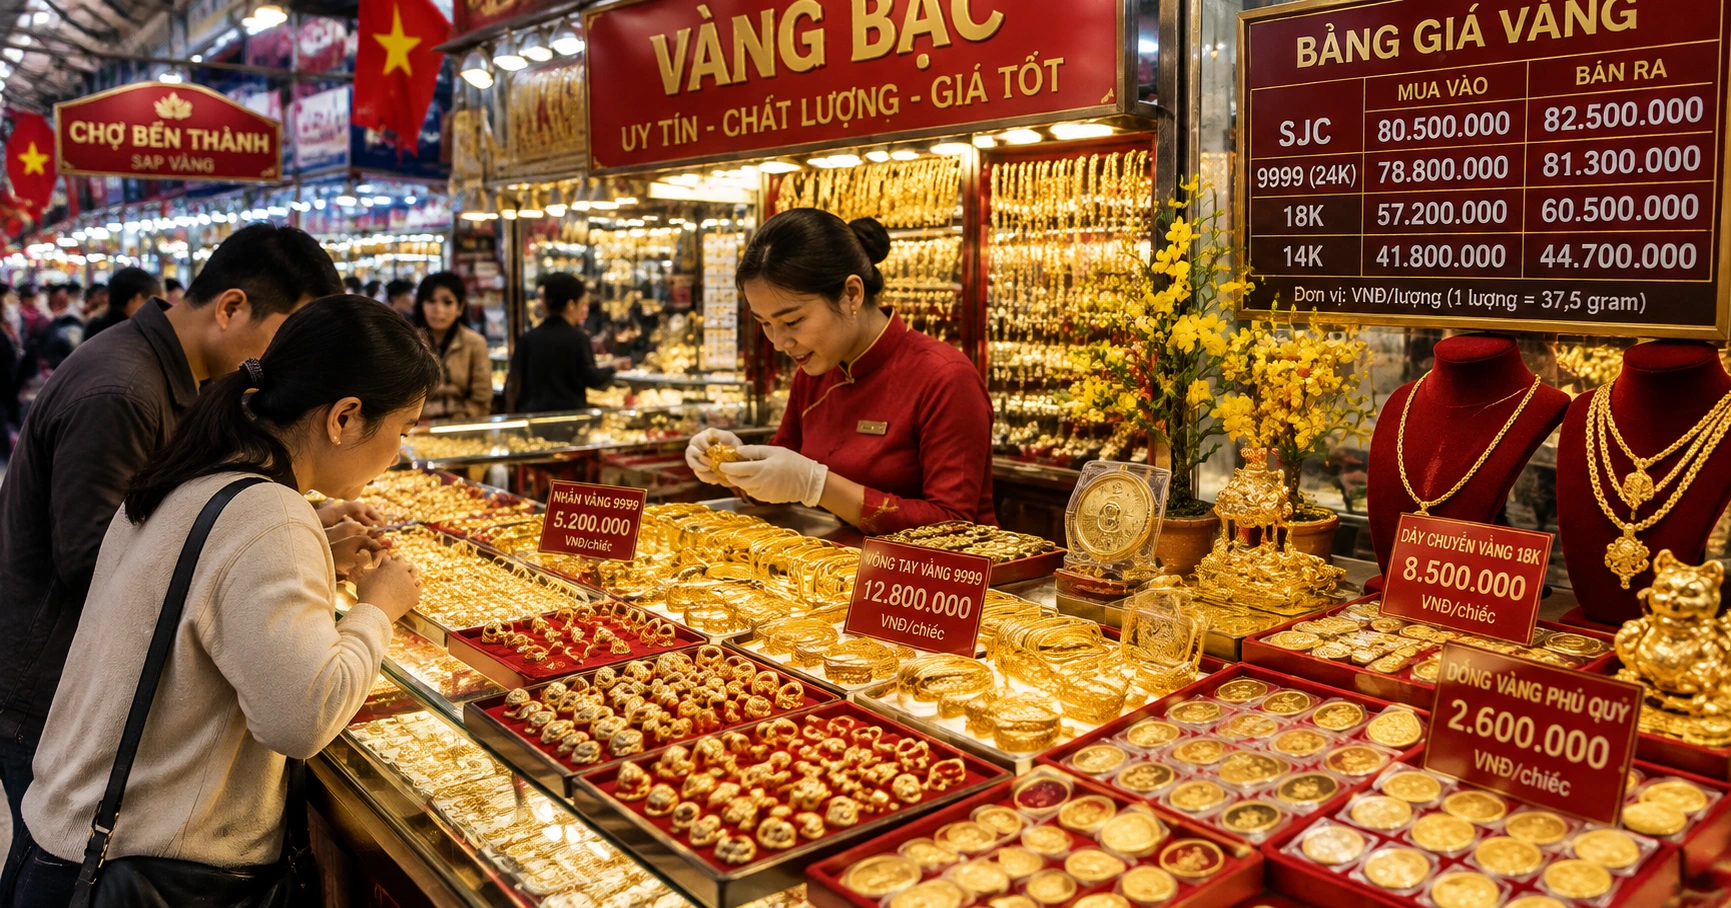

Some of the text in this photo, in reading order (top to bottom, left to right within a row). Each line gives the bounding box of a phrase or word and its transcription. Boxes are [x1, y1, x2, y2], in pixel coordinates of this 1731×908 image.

[649, 0, 1005, 95] VÀNG BẠC
[1296, 23, 1400, 69] BẢNG
[1413, 4, 1486, 55] GIÁ
[1575, 58, 1668, 86] BÁN RA
[1398, 75, 1489, 101] MUA VÀO
[621, 122, 652, 152] UY
[658, 114, 698, 146] TÍN
[722, 94, 793, 138] CHẤT
[930, 62, 989, 110] GIÁ
[1543, 96, 1704, 133] 82.500.000
[69, 121, 125, 150] CHỢ
[187, 126, 269, 153] THÀNH
[1278, 117, 1332, 147] SJC
[1377, 111, 1511, 143] 80.500.000
[1256, 164, 1357, 189] 9999 (24K)
[1378, 155, 1509, 185] 78.800.000
[1542, 145, 1701, 179] 81.300.000
[1283, 204, 1324, 228] 18K
[1377, 200, 1508, 226] 57.200.000
[1541, 193, 1699, 224] 60.500.000
[1283, 245, 1323, 268] 14K
[1376, 244, 1506, 269] 41.800.000
[1540, 242, 1697, 270] 44.700.000
[1294, 286, 1325, 303] Đơn
[1329, 288, 1346, 306] vị:
[1352, 287, 1442, 309] VNĐ/lượng
[1447, 288, 1462, 308] (1
[1468, 288, 1518, 312] lượng
[1541, 291, 1581, 315] 37,5
[1587, 292, 1647, 315] gram)
[553, 510, 631, 536] 5.200.000
[1516, 547, 1542, 566] 18K
[899, 559, 918, 574] TAY
[954, 569, 982, 585] 9999
[1403, 556, 1526, 601] 8.500.000
[863, 579, 972, 620] 12.800.000
[1421, 594, 1496, 624] VNĐ/chiếc
[881, 613, 945, 640] VNĐ/chiếc
[1496, 671, 1542, 703] VÀNG
[1447, 699, 1610, 770] 2.600.000
[1474, 749, 1571, 797] VNĐ/chiếc
